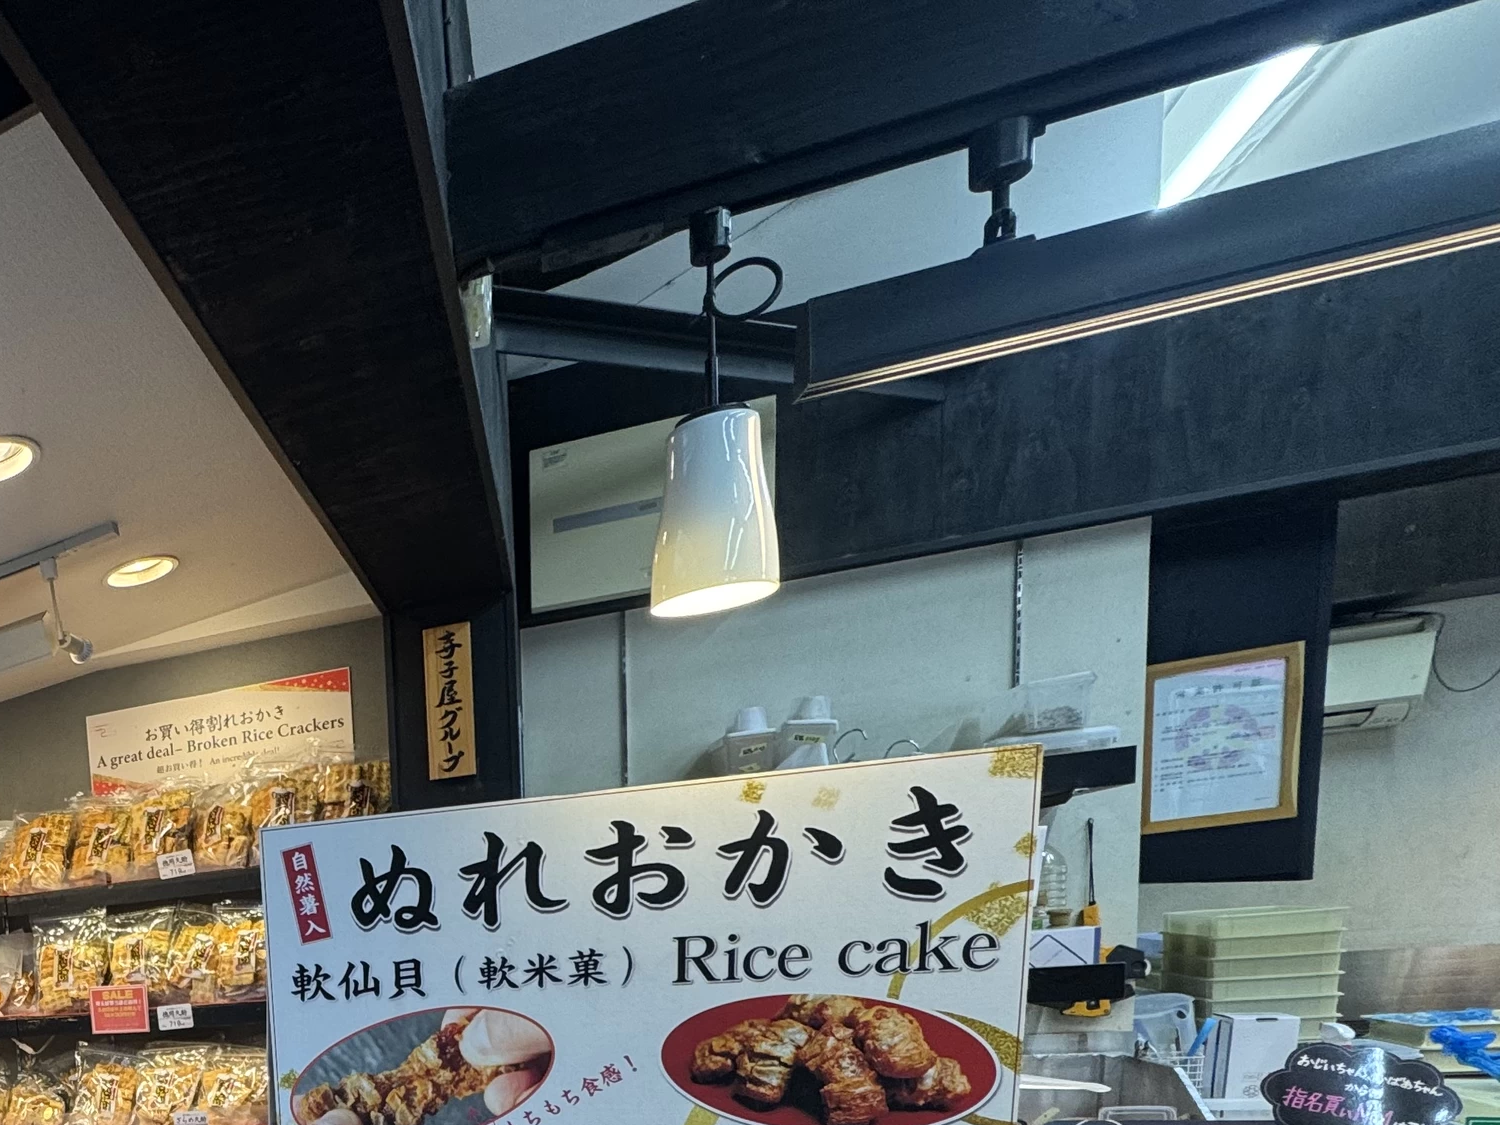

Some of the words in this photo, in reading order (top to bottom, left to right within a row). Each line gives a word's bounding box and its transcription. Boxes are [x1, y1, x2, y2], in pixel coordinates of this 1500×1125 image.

[97, 755, 108, 769] A
[110, 750, 143, 770] great
[186, 733, 238, 754] Broken
[242, 727, 274, 745] Rice
[277, 715, 345, 738] Crackers
[145, 704, 285, 742] お買い得割れおかき
[350, 785, 974, 932] ぬれおかき
[291, 850, 327, 937] 自然薯入
[672, 933, 811, 985] Rice
[837, 920, 1000, 977] cake
[102, 989, 134, 1000] SALE
